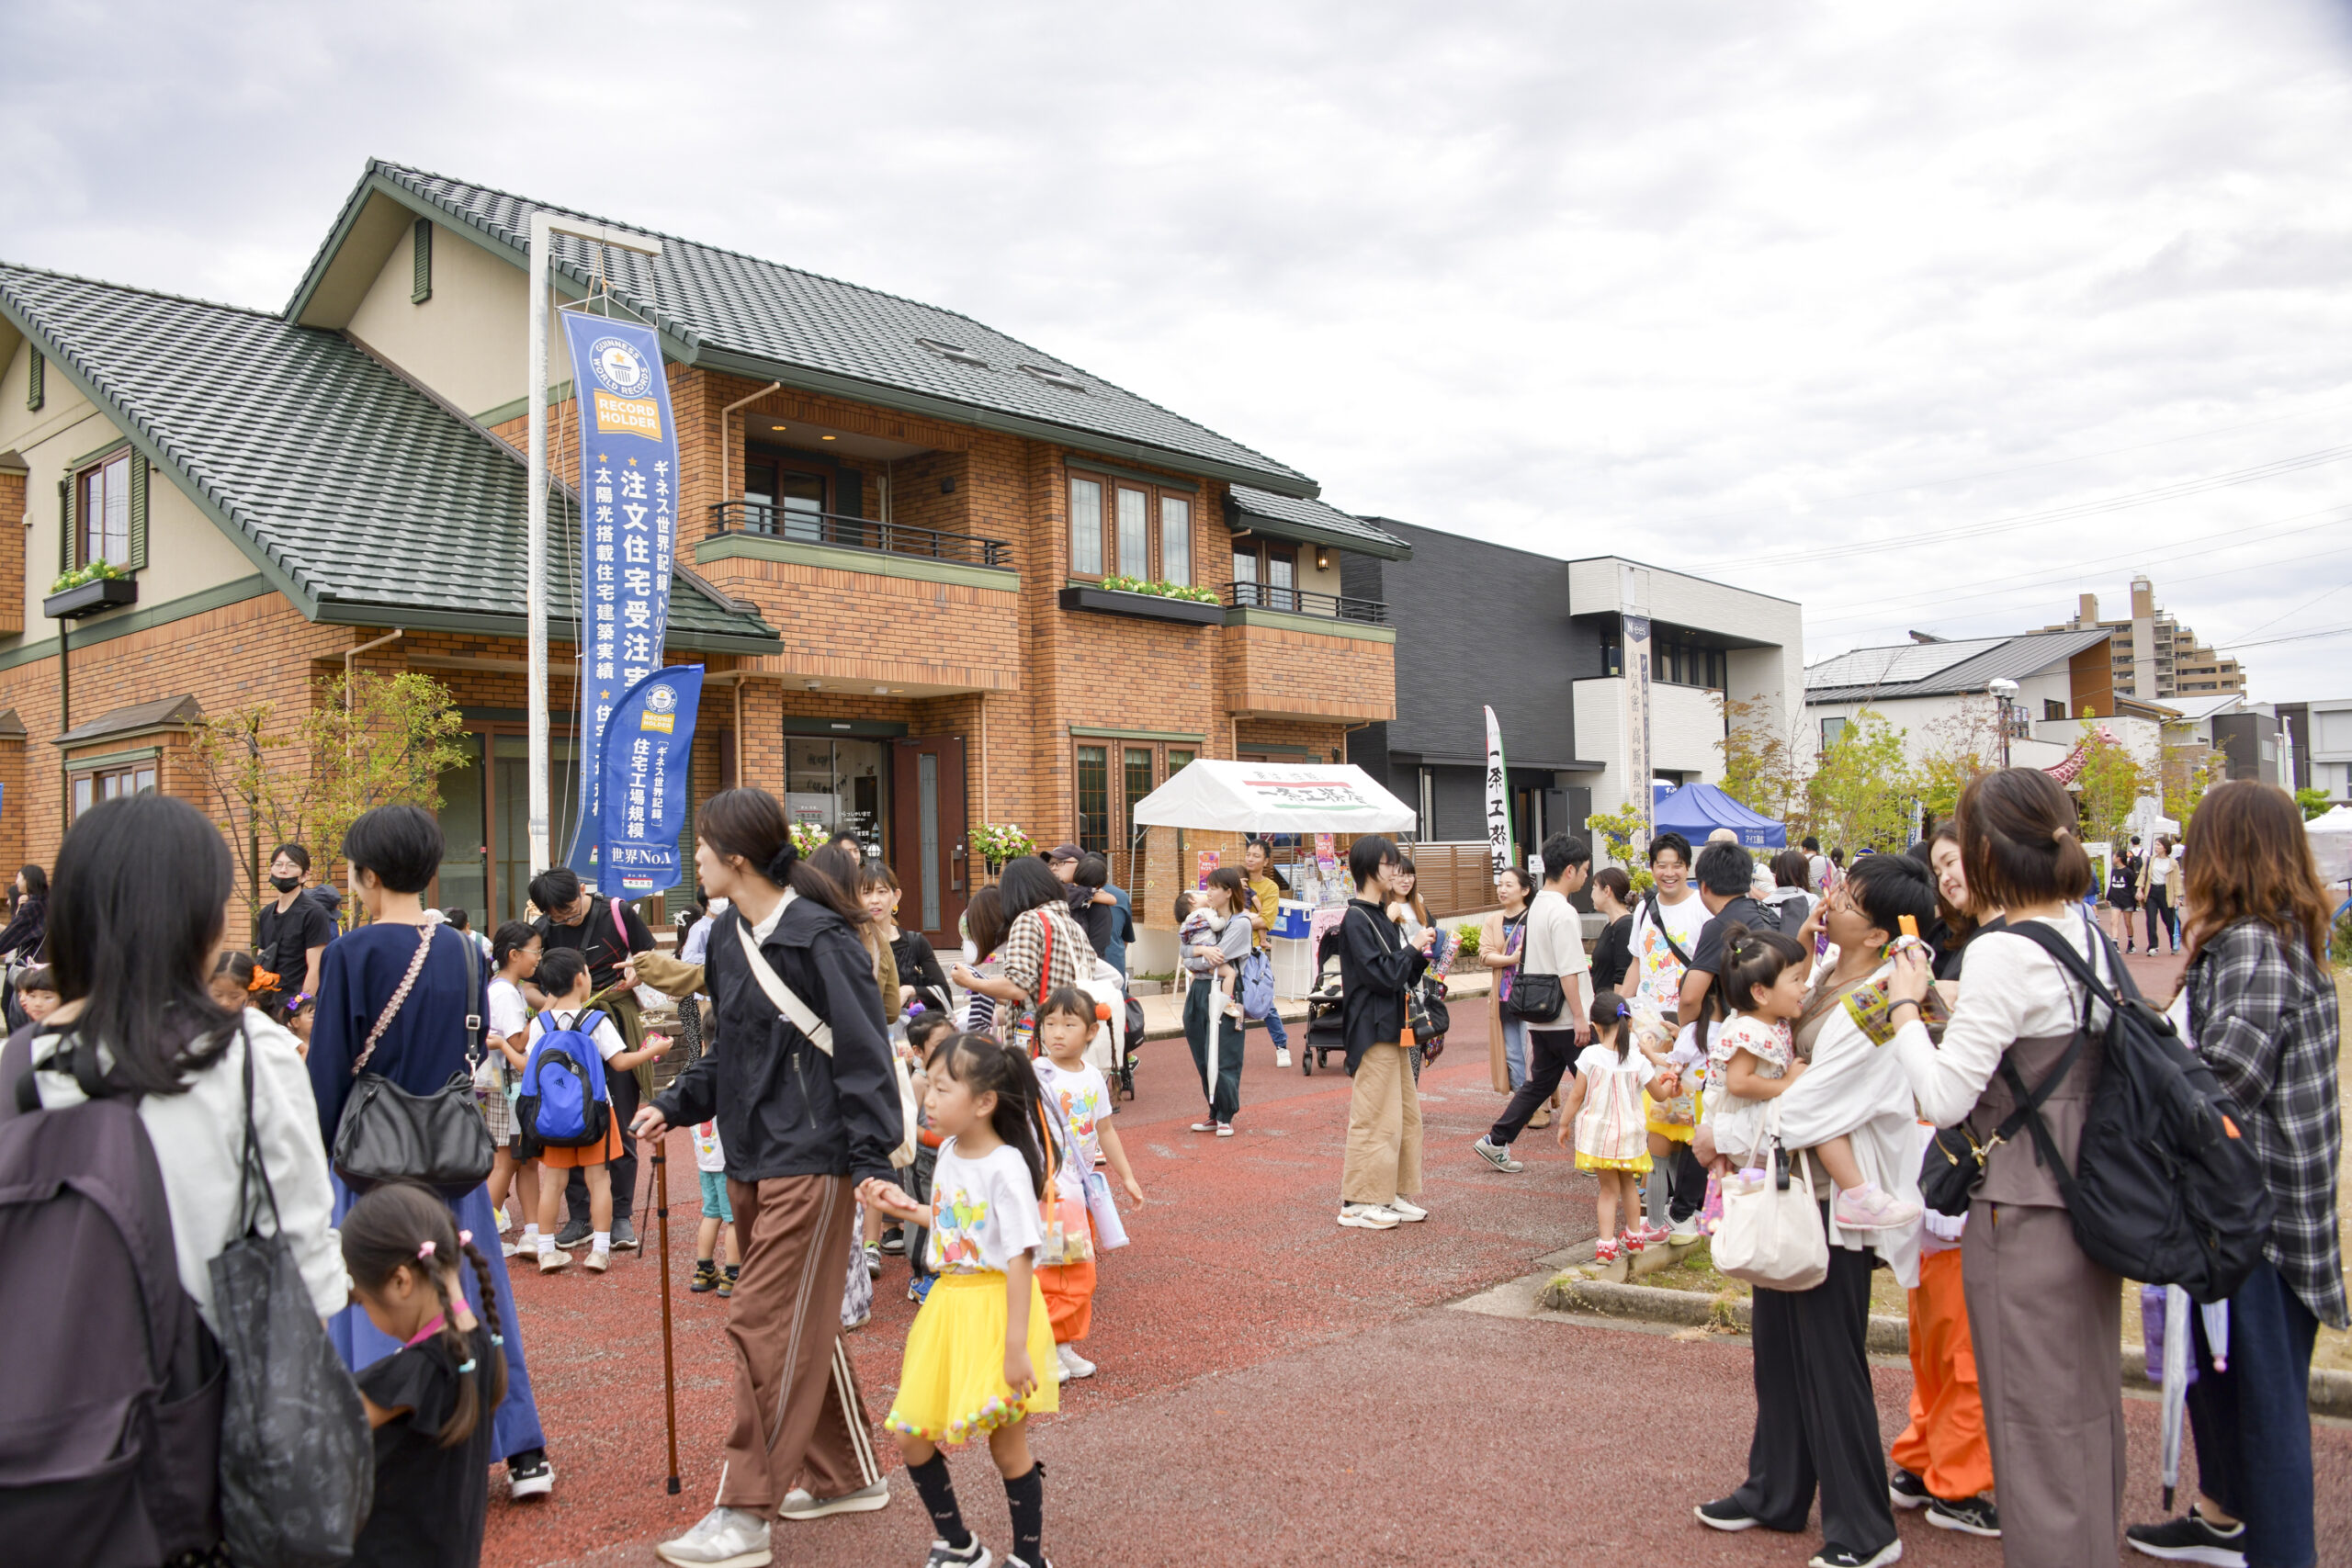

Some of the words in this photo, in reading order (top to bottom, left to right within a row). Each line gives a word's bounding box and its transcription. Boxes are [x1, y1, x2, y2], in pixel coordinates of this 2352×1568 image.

[595, 339, 640, 359] GUINNESS
[593, 358, 618, 391] WORLD
[621, 367, 649, 395] RECORDS
[598, 398, 655, 416] RECORD
[600, 411, 657, 429] HOLDER
[594, 467, 615, 680] 太陽光搭載住宅建築実績
[643, 720, 672, 729] HOLDER
[644, 714, 673, 723] RECORD
[627, 738, 651, 839] 住宅工場規模
